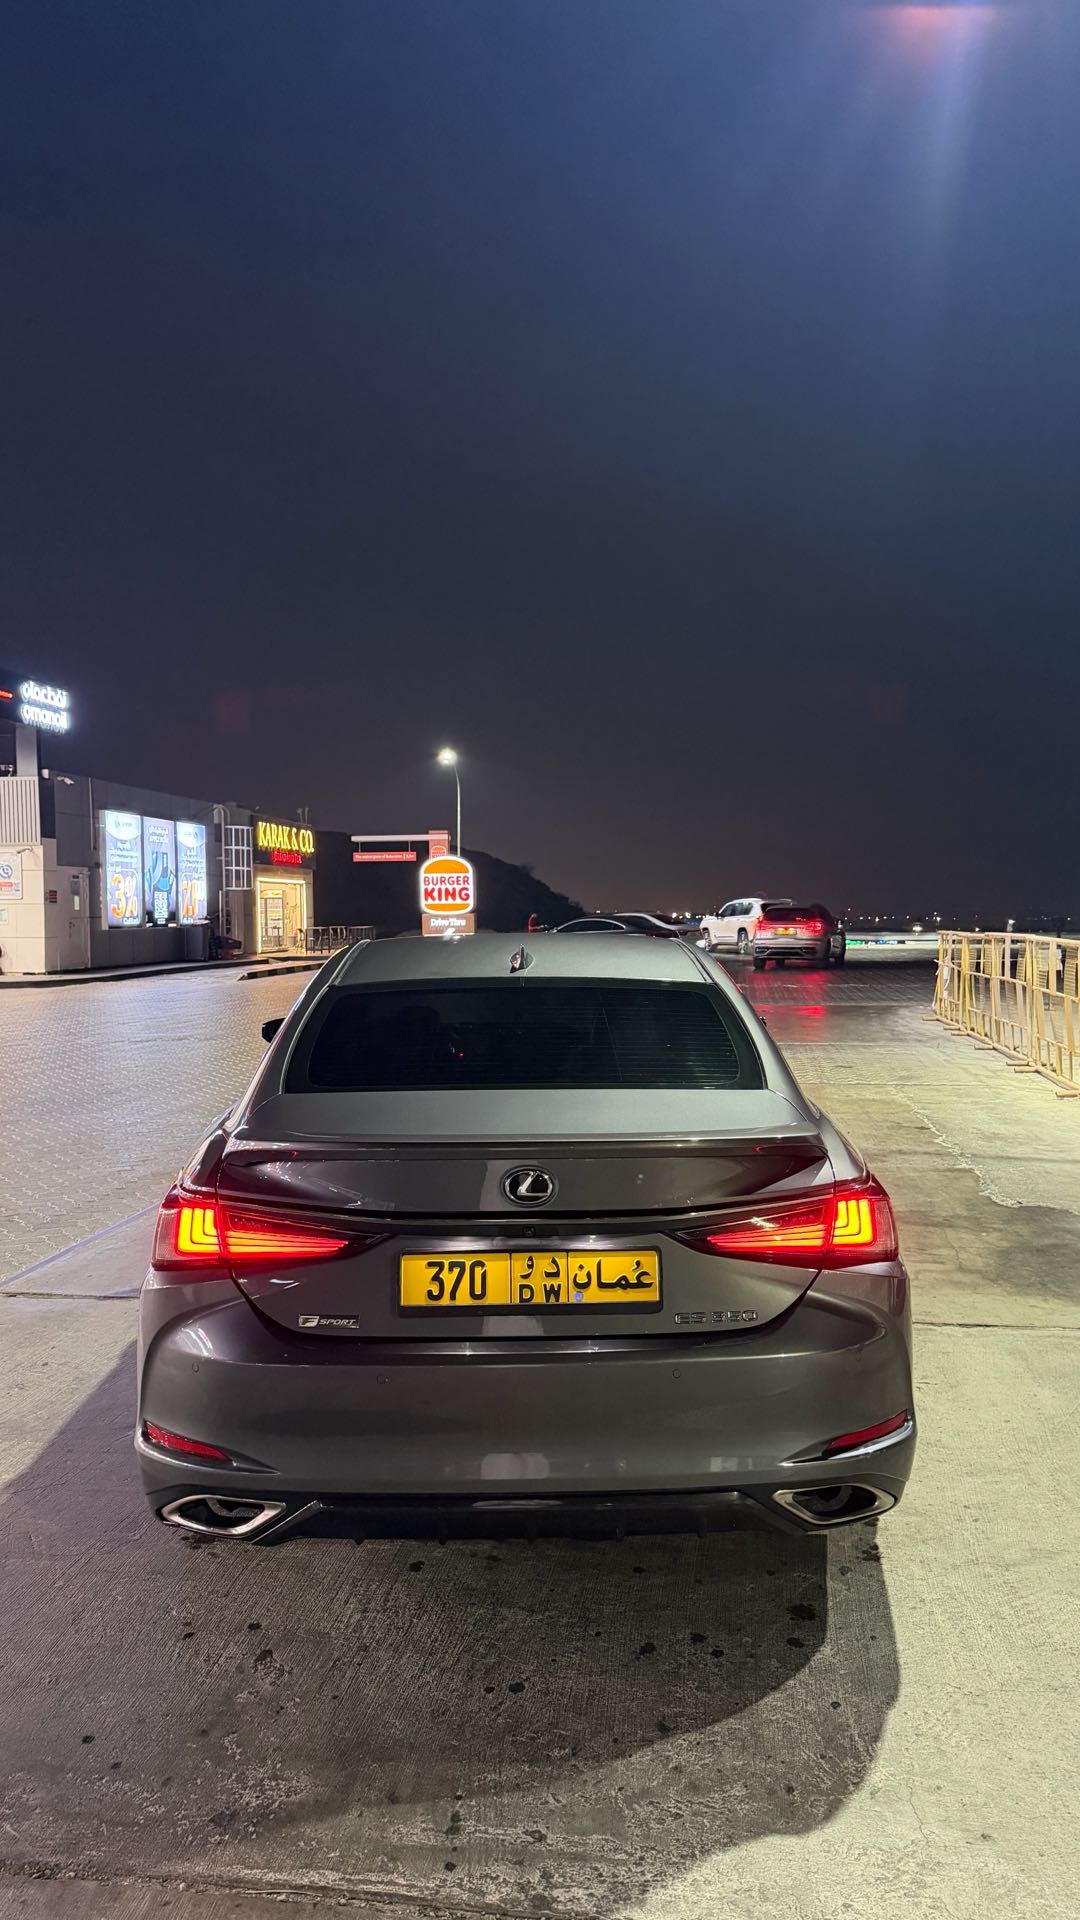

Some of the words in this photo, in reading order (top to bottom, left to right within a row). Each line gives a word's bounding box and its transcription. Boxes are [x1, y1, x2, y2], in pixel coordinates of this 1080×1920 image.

[258, 821, 291, 850] KARAK
[291, 827, 299, 850] &
[423, 876, 470, 886] BURGER
[424, 887, 470, 902] KING
[425, 1260, 487, 1301] 370
[675, 1312, 706, 1324] ES
